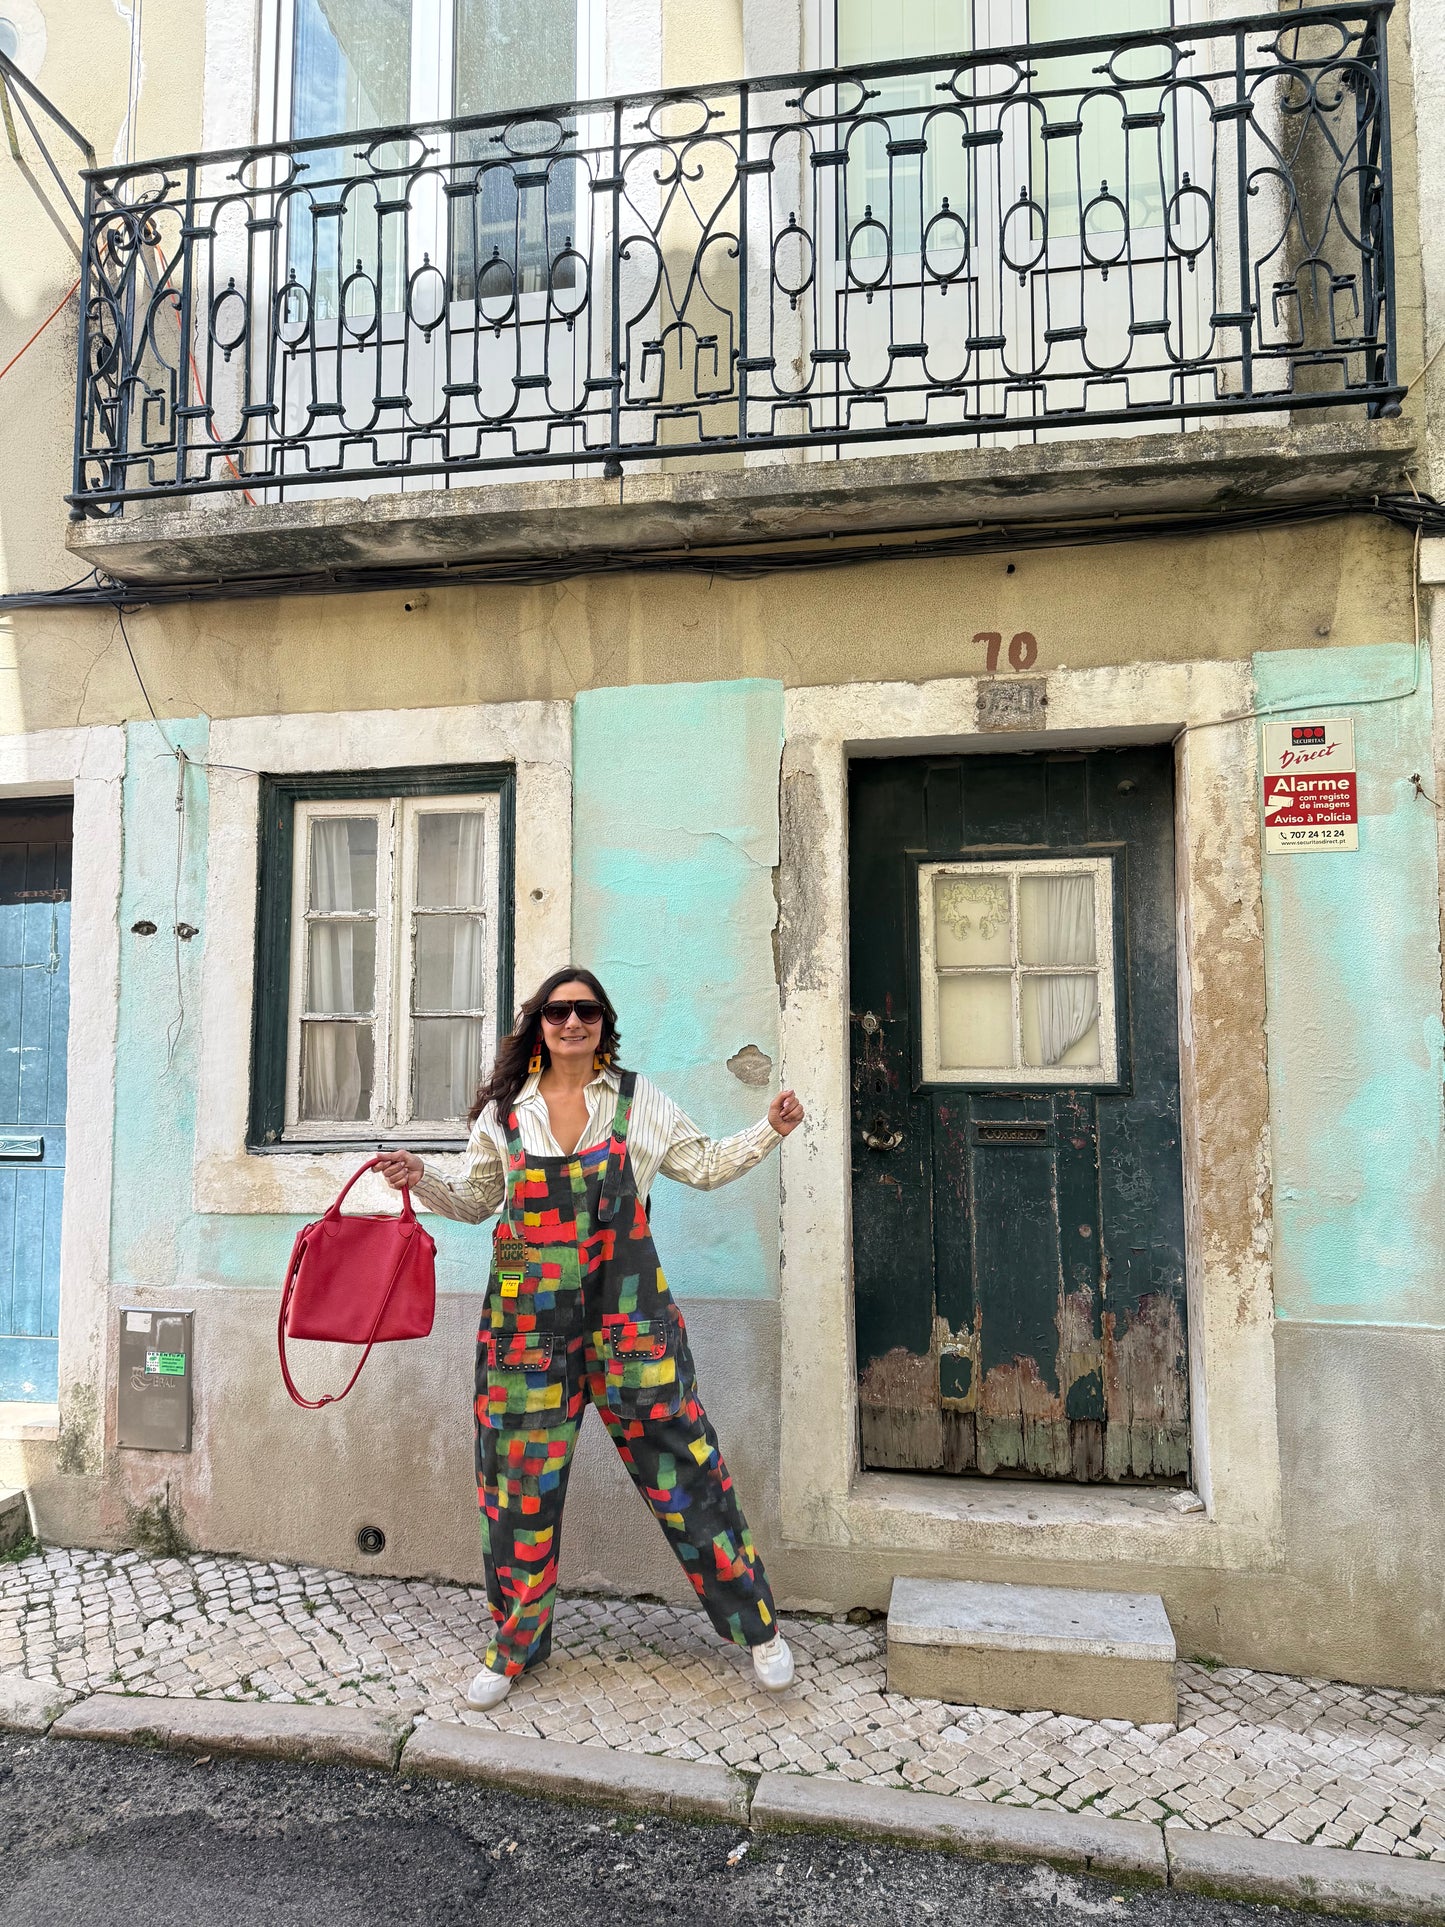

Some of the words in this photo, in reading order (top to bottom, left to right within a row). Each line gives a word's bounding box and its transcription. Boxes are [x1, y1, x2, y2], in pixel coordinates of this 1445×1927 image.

[971, 631, 1038, 673] 70
[1279, 742, 1342, 769] Direct
[1273, 777, 1350, 793] Alarme
[1319, 792, 1350, 802] registo
[1299, 801, 1311, 809] de
[1313, 800, 1350, 810] imagens
[1274, 814, 1304, 824] Aviso
[1307, 813, 1313, 822] à
[1316, 812, 1351, 822] Polícia
[1290, 831, 1306, 839] 707
[1308, 830, 1319, 838] 24
[1321, 830, 1331, 838] 12
[1333, 829, 1345, 837] 24
[1281, 838, 1346, 846] www.securitasdirect.pt
